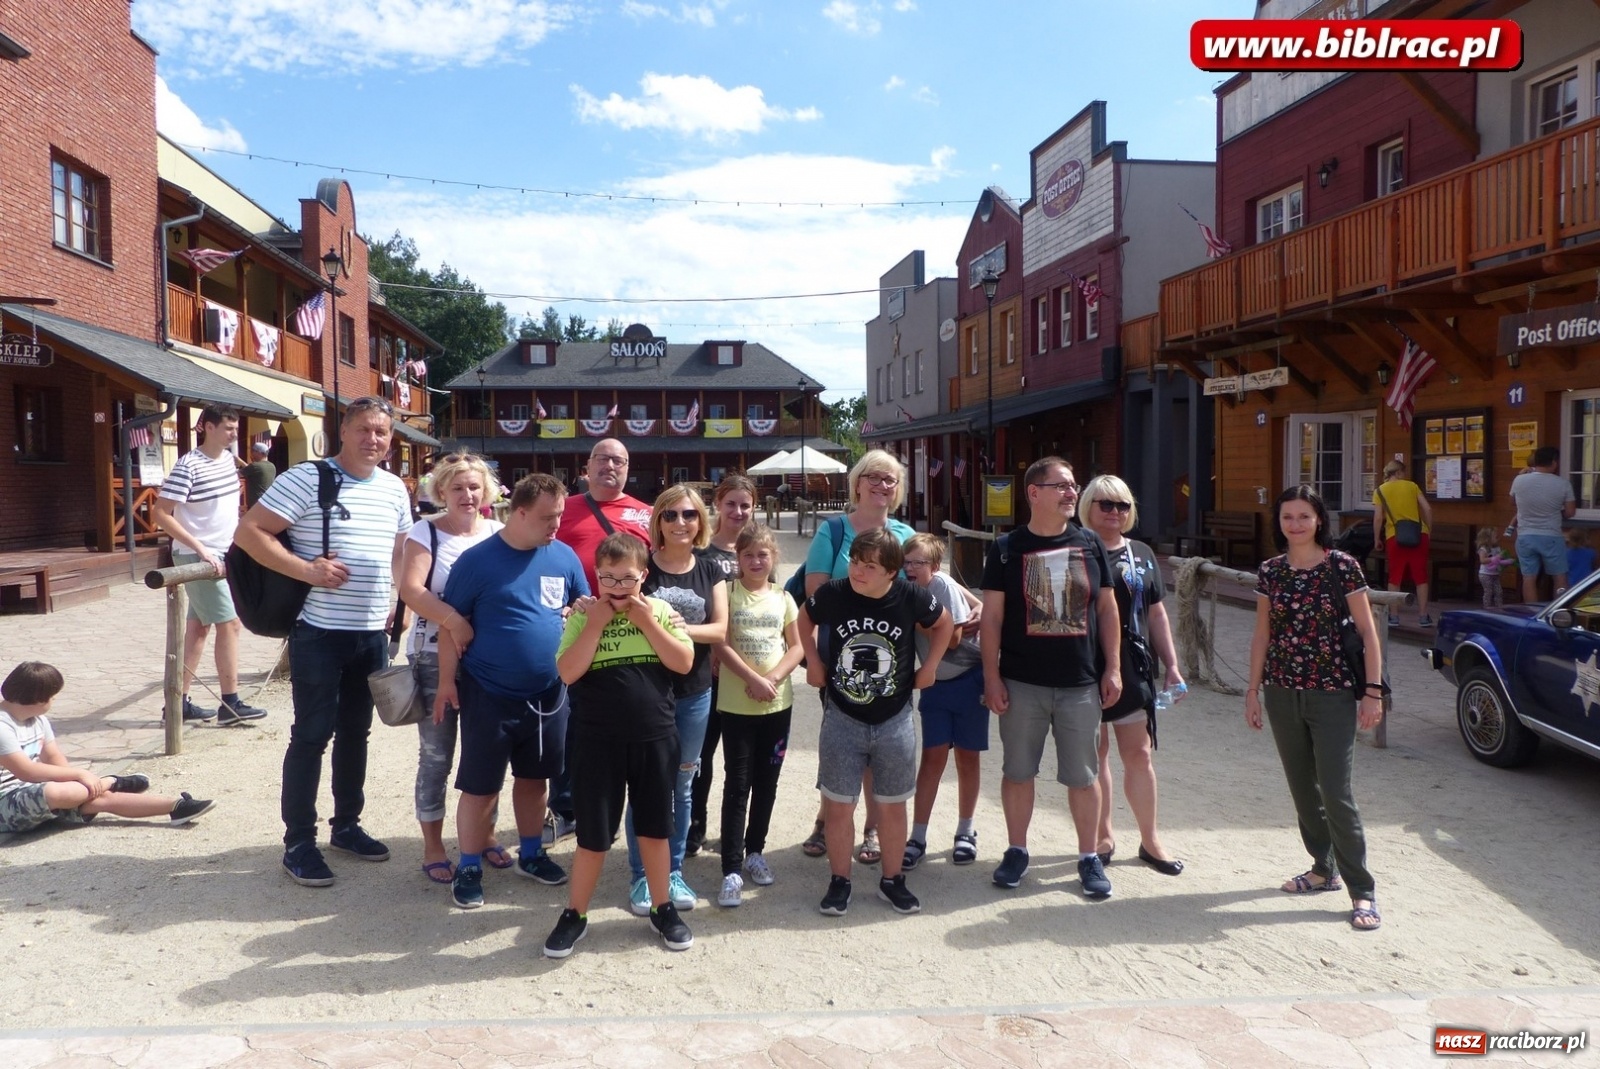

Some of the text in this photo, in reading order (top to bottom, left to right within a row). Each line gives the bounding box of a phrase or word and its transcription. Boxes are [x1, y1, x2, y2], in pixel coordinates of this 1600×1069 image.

[1518, 323, 1552, 346] Post
[611, 342, 665, 357] SALOON
[1509, 387, 1523, 404] 11
[1257, 413, 1266, 425] 12
[836, 617, 903, 641] ERROR
